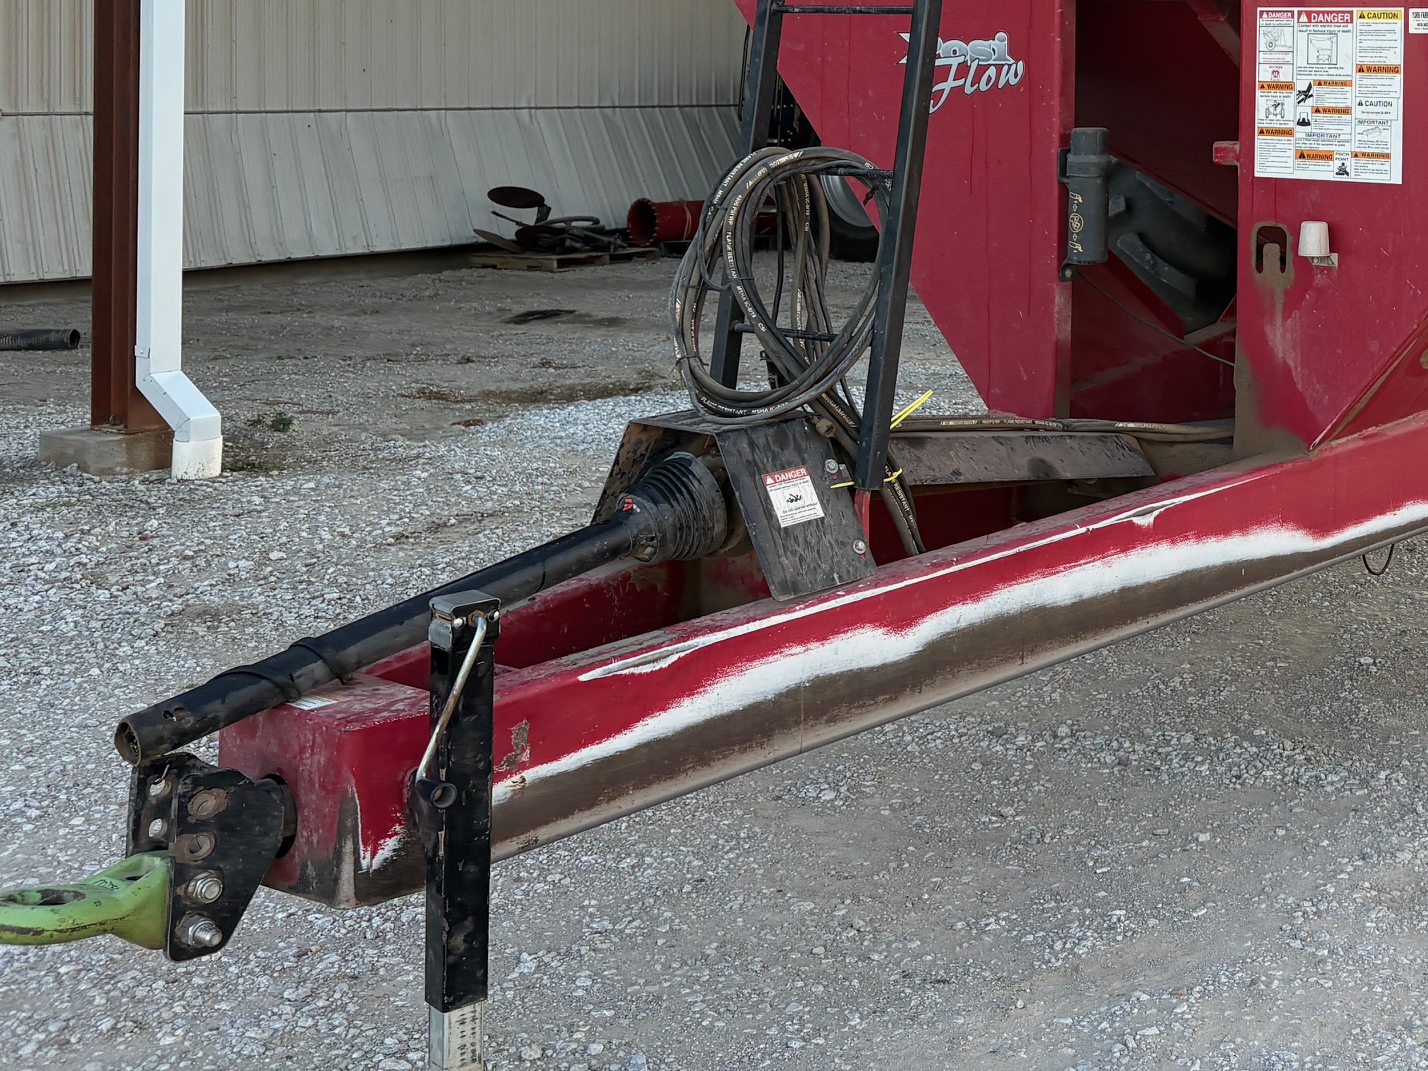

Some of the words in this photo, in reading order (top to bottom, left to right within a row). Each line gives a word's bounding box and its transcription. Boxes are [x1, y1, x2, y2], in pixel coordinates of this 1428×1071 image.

[1311, 13, 1351, 23] DANGER
[897, 30, 1015, 66] osi
[929, 55, 1024, 114] Flow
[774, 468, 807, 482] DANGER
